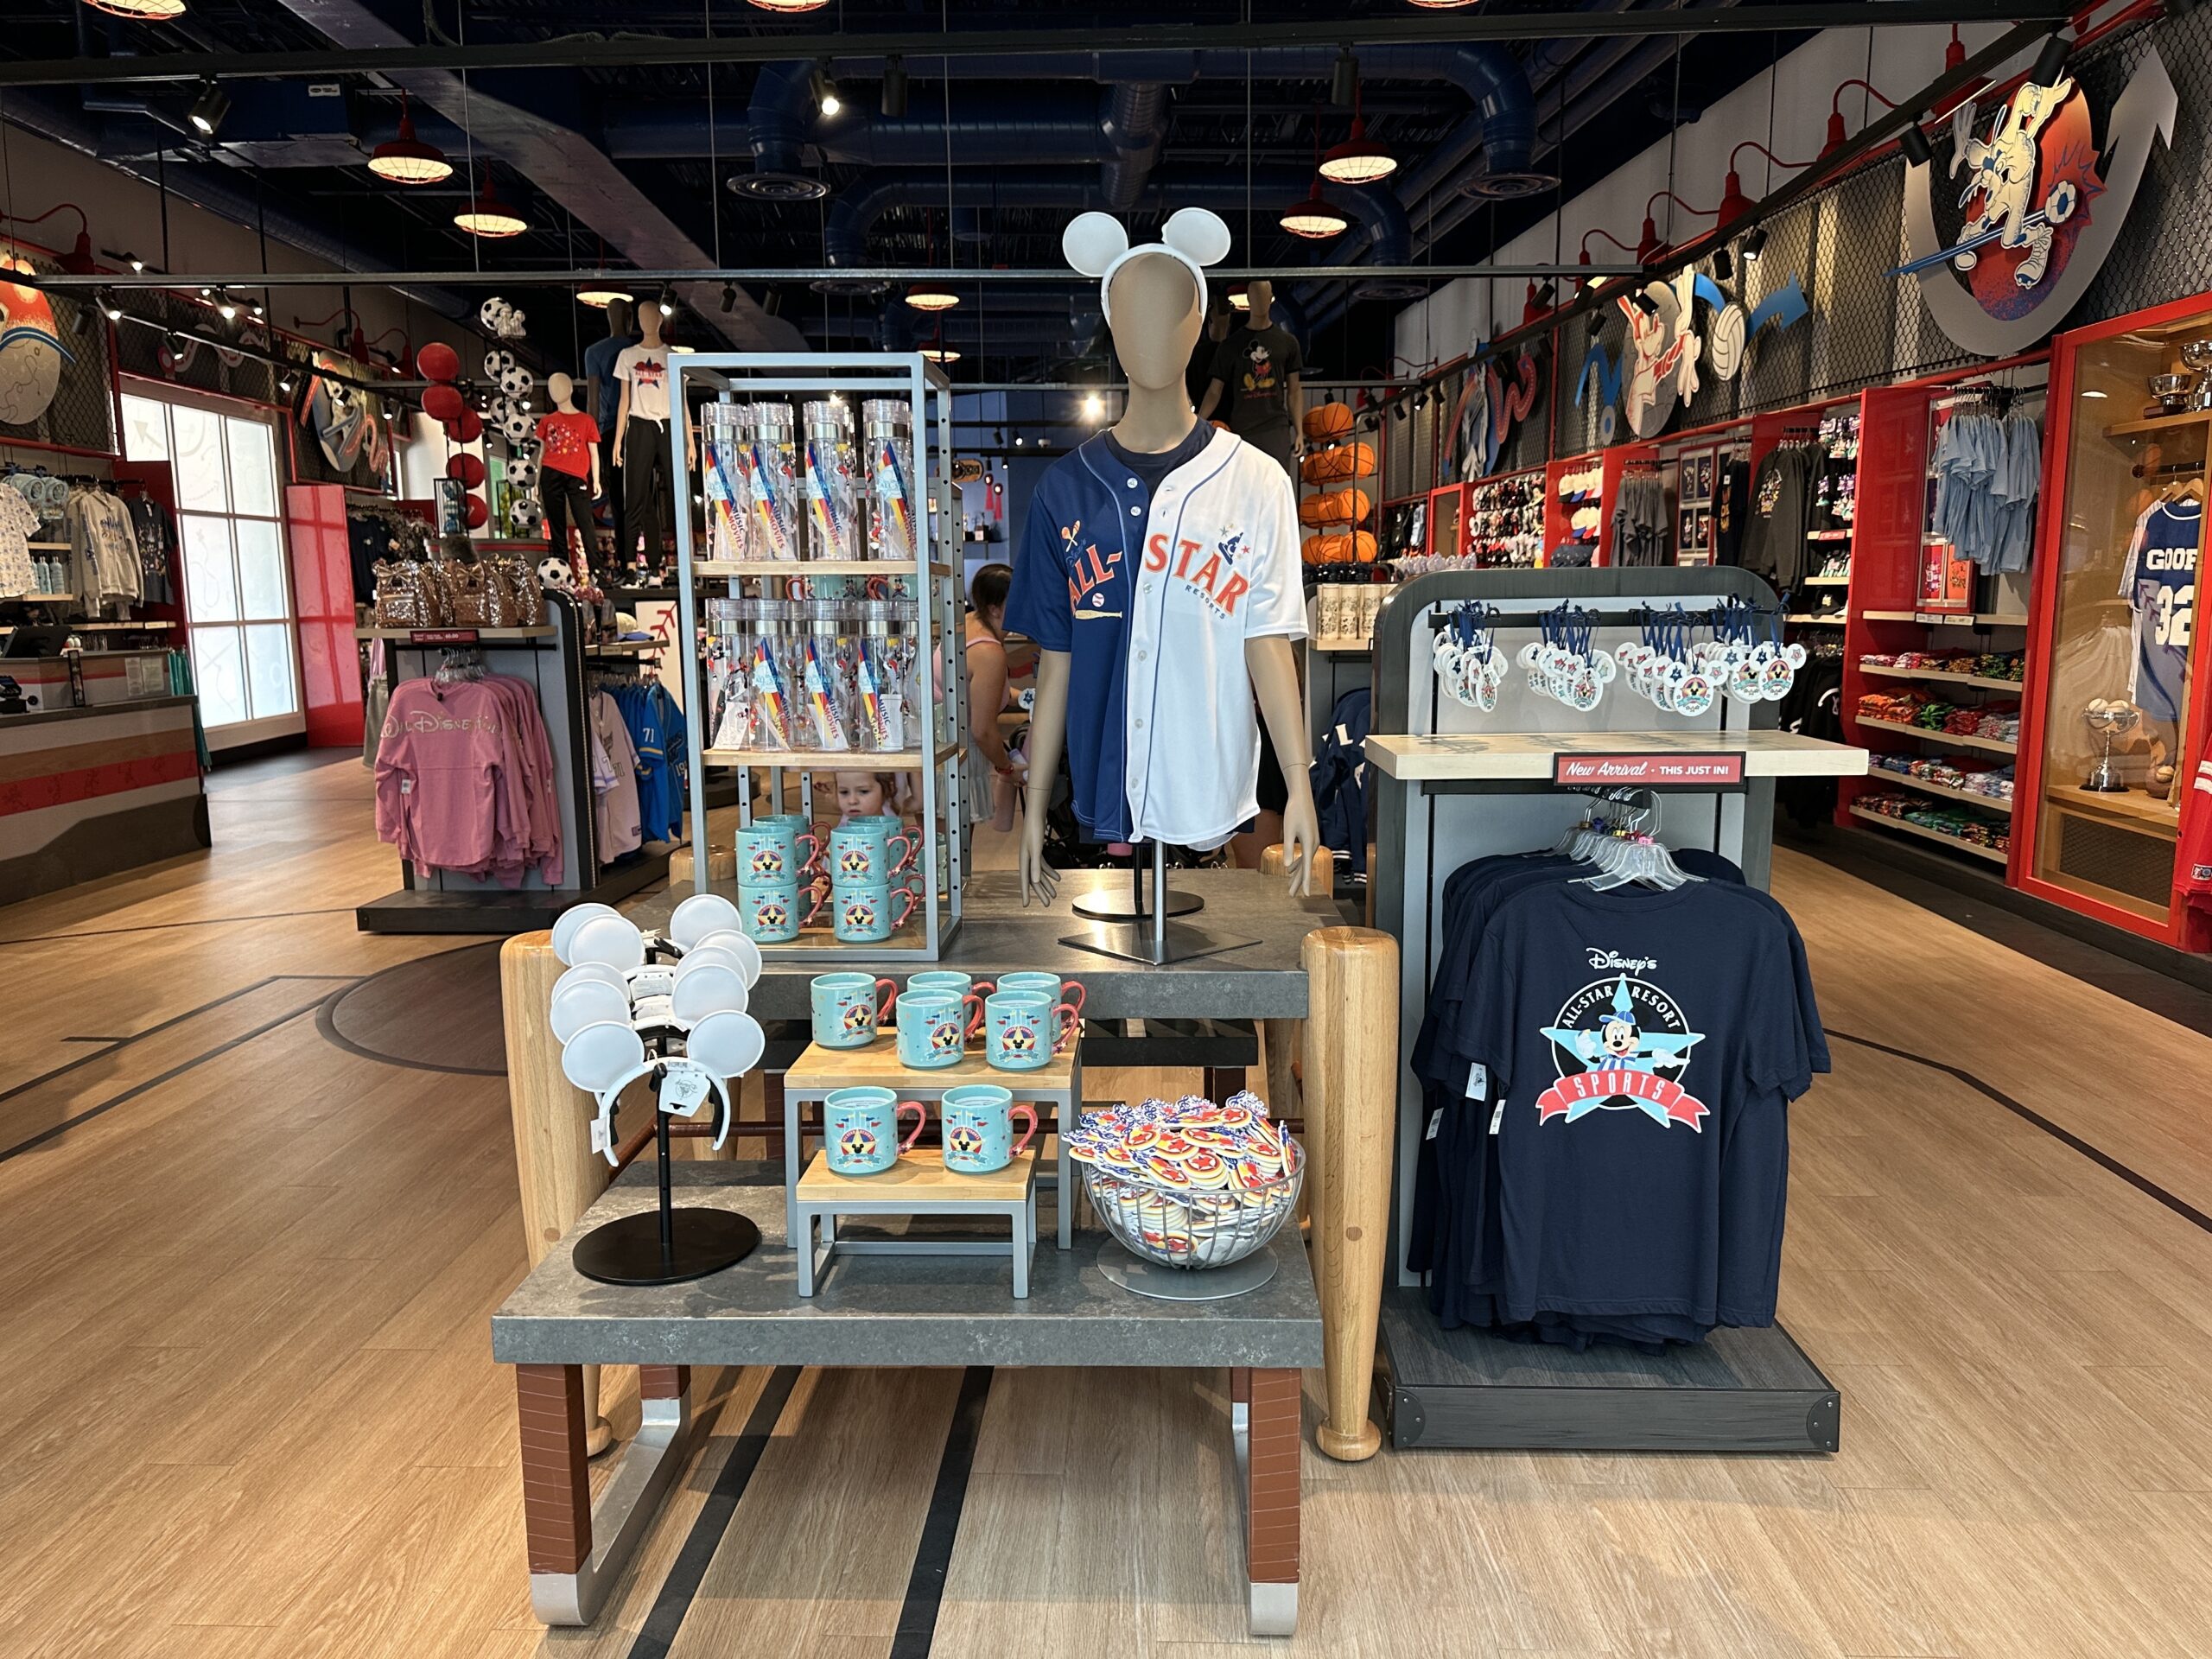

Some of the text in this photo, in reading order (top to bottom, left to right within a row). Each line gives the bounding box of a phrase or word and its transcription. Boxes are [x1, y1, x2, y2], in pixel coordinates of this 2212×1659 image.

[727, 515, 744, 550] MOVIES
[769, 515, 785, 549] MOVIES
[2146, 547, 2197, 570] GOOF
[1144, 533, 1249, 619] STAR
[1185, 585, 1225, 620] RESORTS
[2155, 585, 2195, 645] 32
[823, 704, 839, 740] MOVIES
[829, 697, 841, 725] MUSIC
[878, 699, 891, 726] MUSIC
[643, 728, 654, 742] 71
[1566, 761, 1728, 776] New Arrival THIS JUST IN!
[1561, 984, 1681, 1029] ALL-STAR RESORT
[1573, 1071, 1666, 1100] SPORTS
